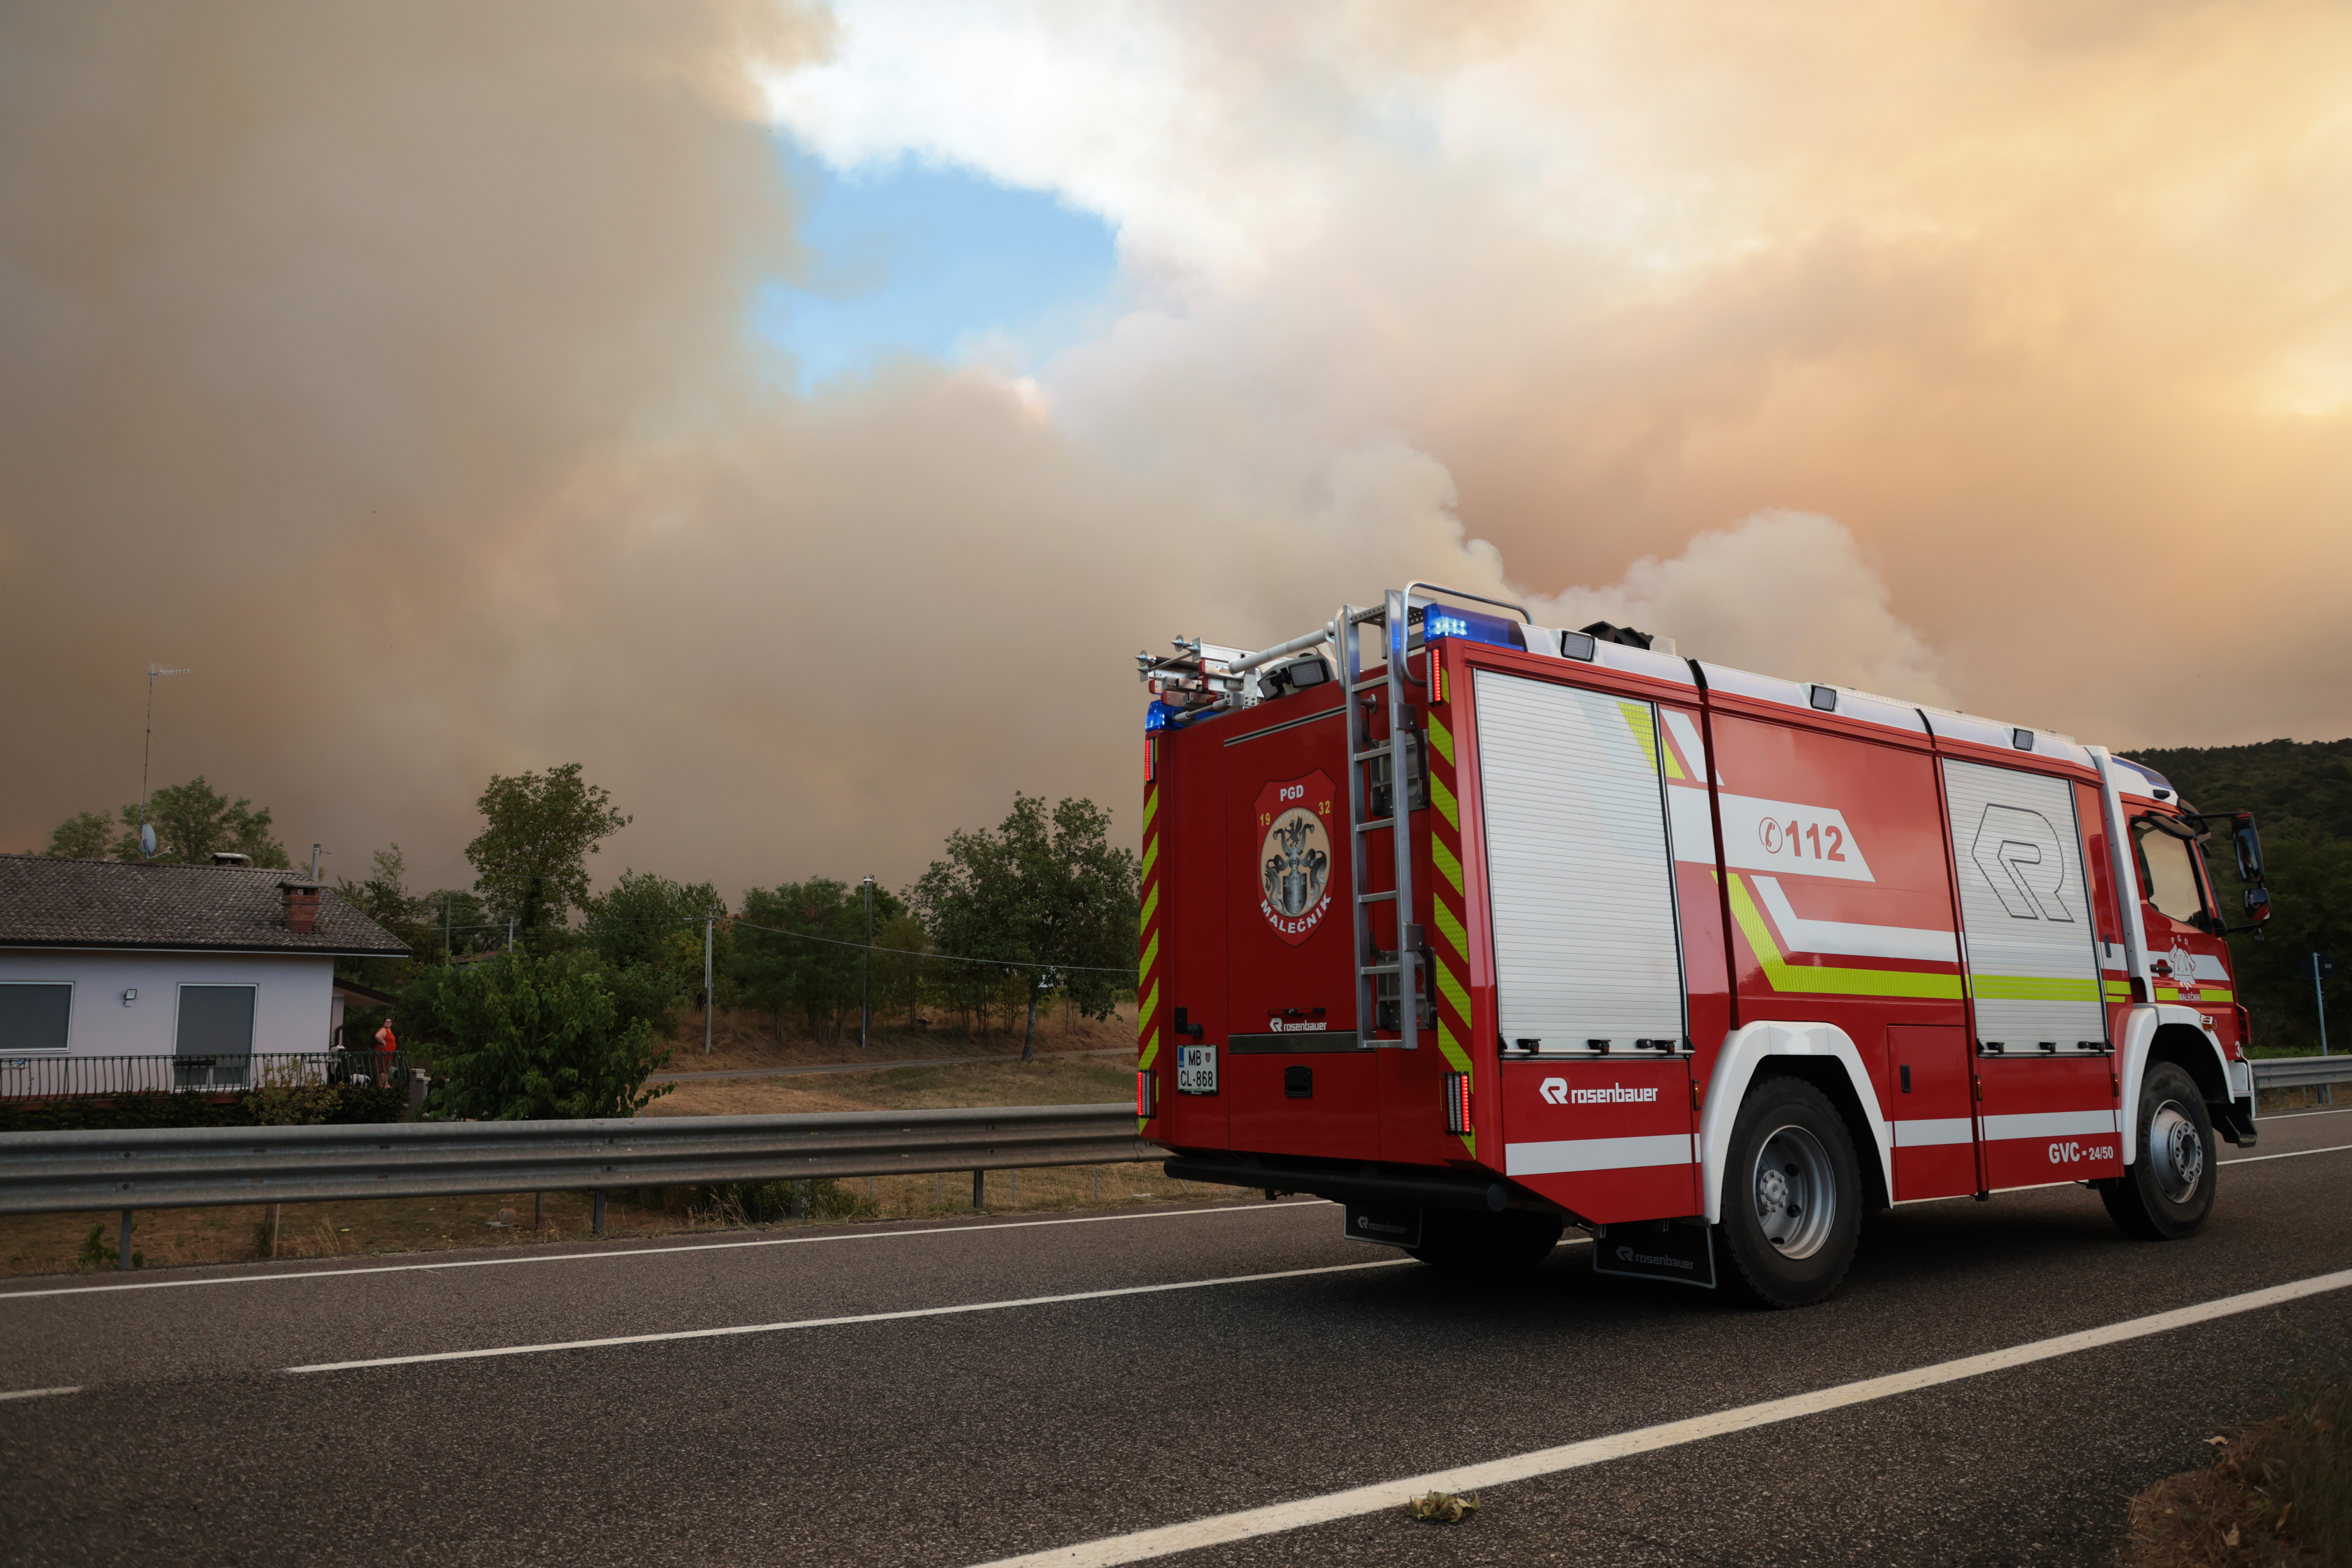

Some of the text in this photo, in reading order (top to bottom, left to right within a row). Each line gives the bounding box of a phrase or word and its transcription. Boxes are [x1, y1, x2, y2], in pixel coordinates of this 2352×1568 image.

[1280, 785, 1304, 802] PGD
[1260, 800, 1330, 826] 19 32
[1275, 810, 1314, 827] SAINT PETER
[1785, 820, 1846, 862] 112
[1261, 893, 1331, 933] MALEČNIK
[2178, 992, 2201, 1001] MALEČNIK
[1284, 1020, 1327, 1031] rosenbauer
[1189, 1050, 1201, 1066] MB
[1181, 1071, 1213, 1087] CL-868
[1571, 1082, 1658, 1103] rosenbauer
[1369, 1222, 1407, 1234] rosenbauer
[1635, 1254, 1694, 1270] rosenbauer
